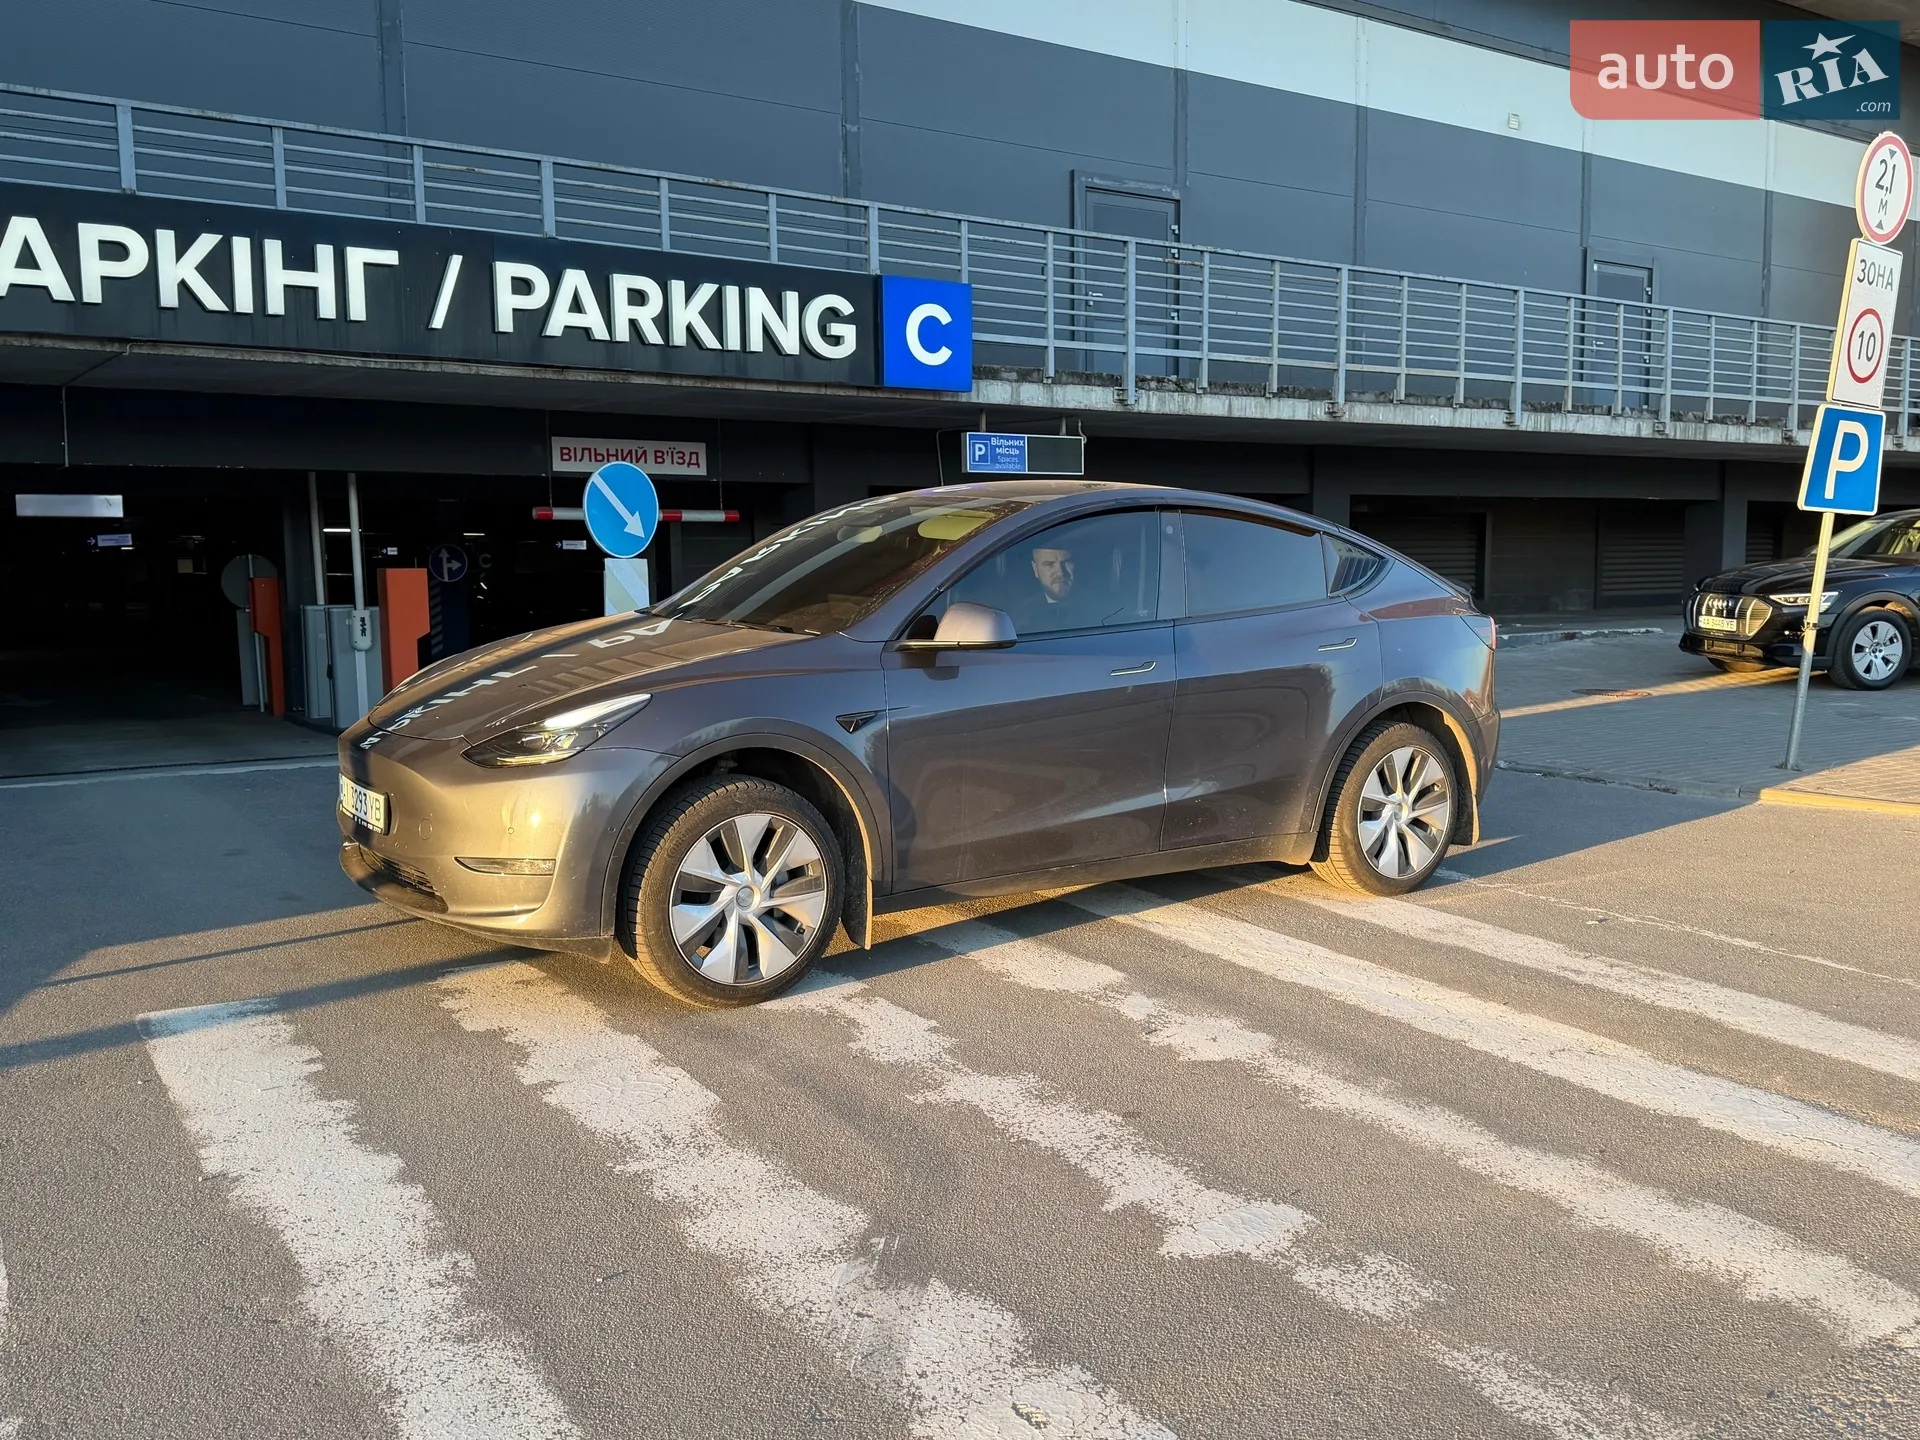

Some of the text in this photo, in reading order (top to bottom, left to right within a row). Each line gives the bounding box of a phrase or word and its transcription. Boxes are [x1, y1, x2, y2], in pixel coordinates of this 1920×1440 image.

[1857, 258, 1894, 292] ЗОНА
[429, 254, 463, 329] /
[492, 260, 857, 360] PARKING
[1857, 329, 1876, 353] 10
[991, 437, 1024, 447] Вільних
[996, 445, 1020, 455] місць
[559, 446, 701, 468] ВІЛЬНИЙ В'ЇЗД
[997, 455, 1019, 463] Spaces
[1824, 420, 1868, 499] P
